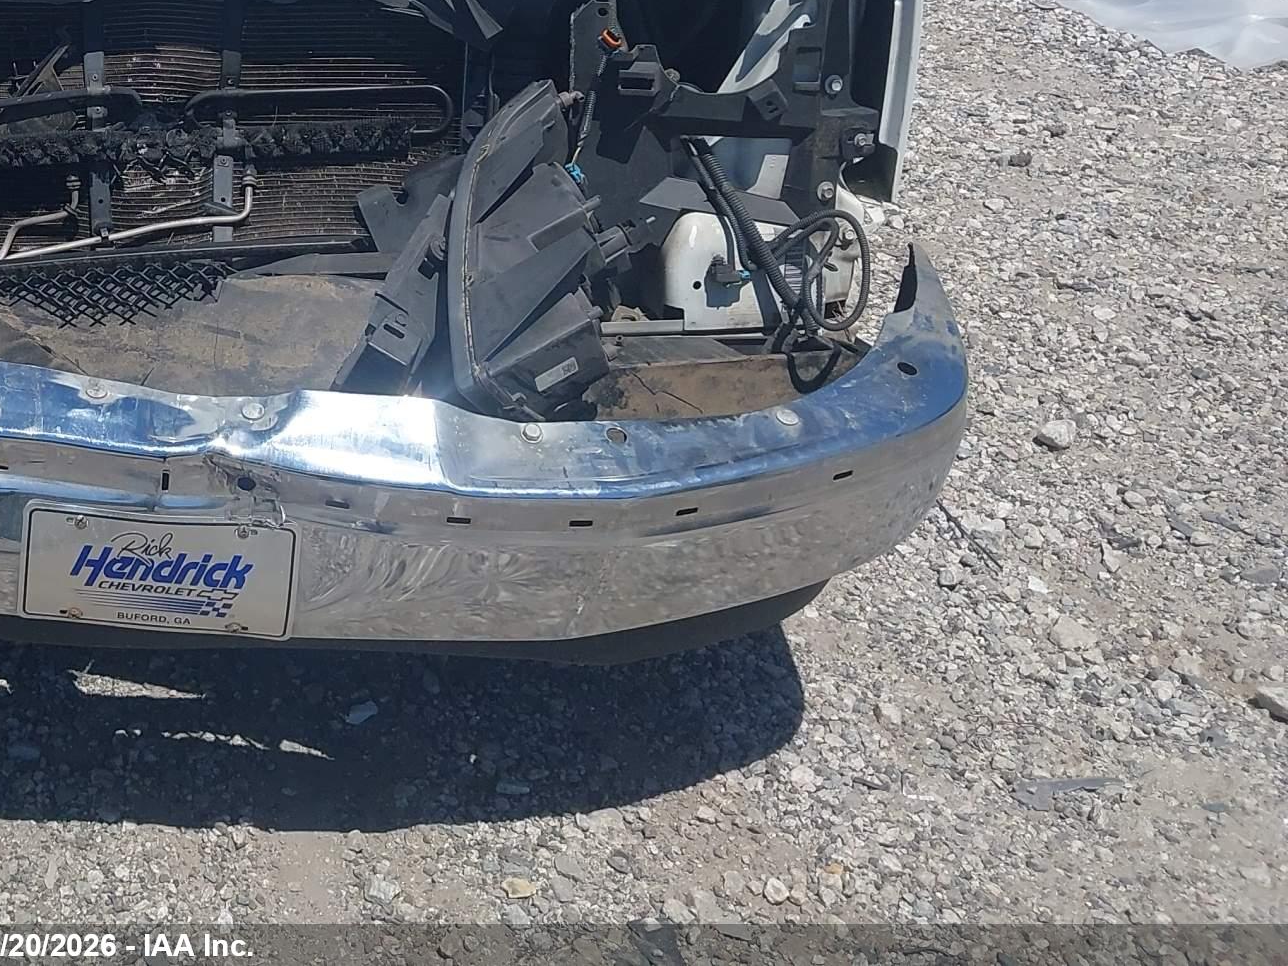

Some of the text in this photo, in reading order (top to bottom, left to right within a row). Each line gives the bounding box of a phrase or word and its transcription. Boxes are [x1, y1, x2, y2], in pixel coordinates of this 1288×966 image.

[110, 532, 175, 565] Rick
[70, 544, 253, 590] Hendrick
[98, 580, 199, 598] CHEVROLET
[117, 610, 192, 626] BUFORD, GA
